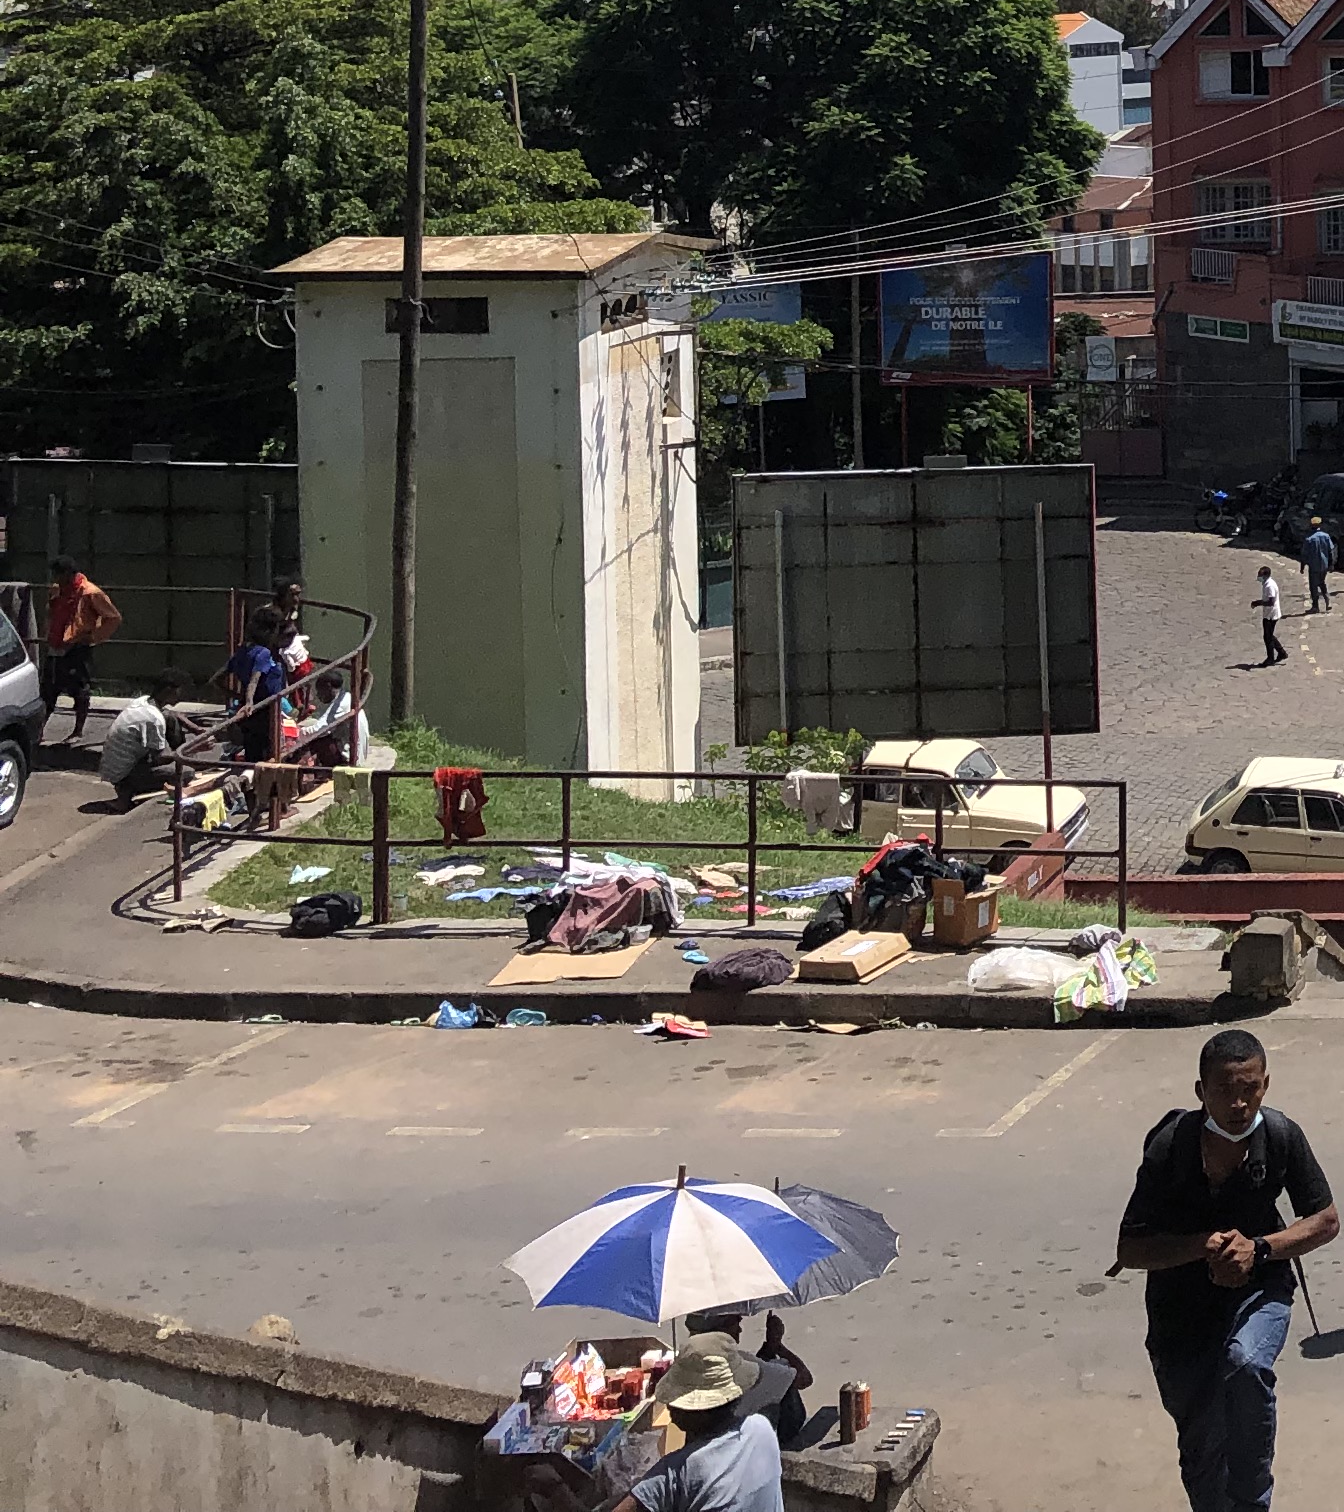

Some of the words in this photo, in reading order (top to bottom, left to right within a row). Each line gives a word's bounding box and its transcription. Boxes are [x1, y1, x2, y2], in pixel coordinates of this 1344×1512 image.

[909, 297, 934, 305] POUR
[921, 307, 987, 319] DURABLE
[931, 321, 946, 330] DE
[949, 321, 985, 330] NOTRE
